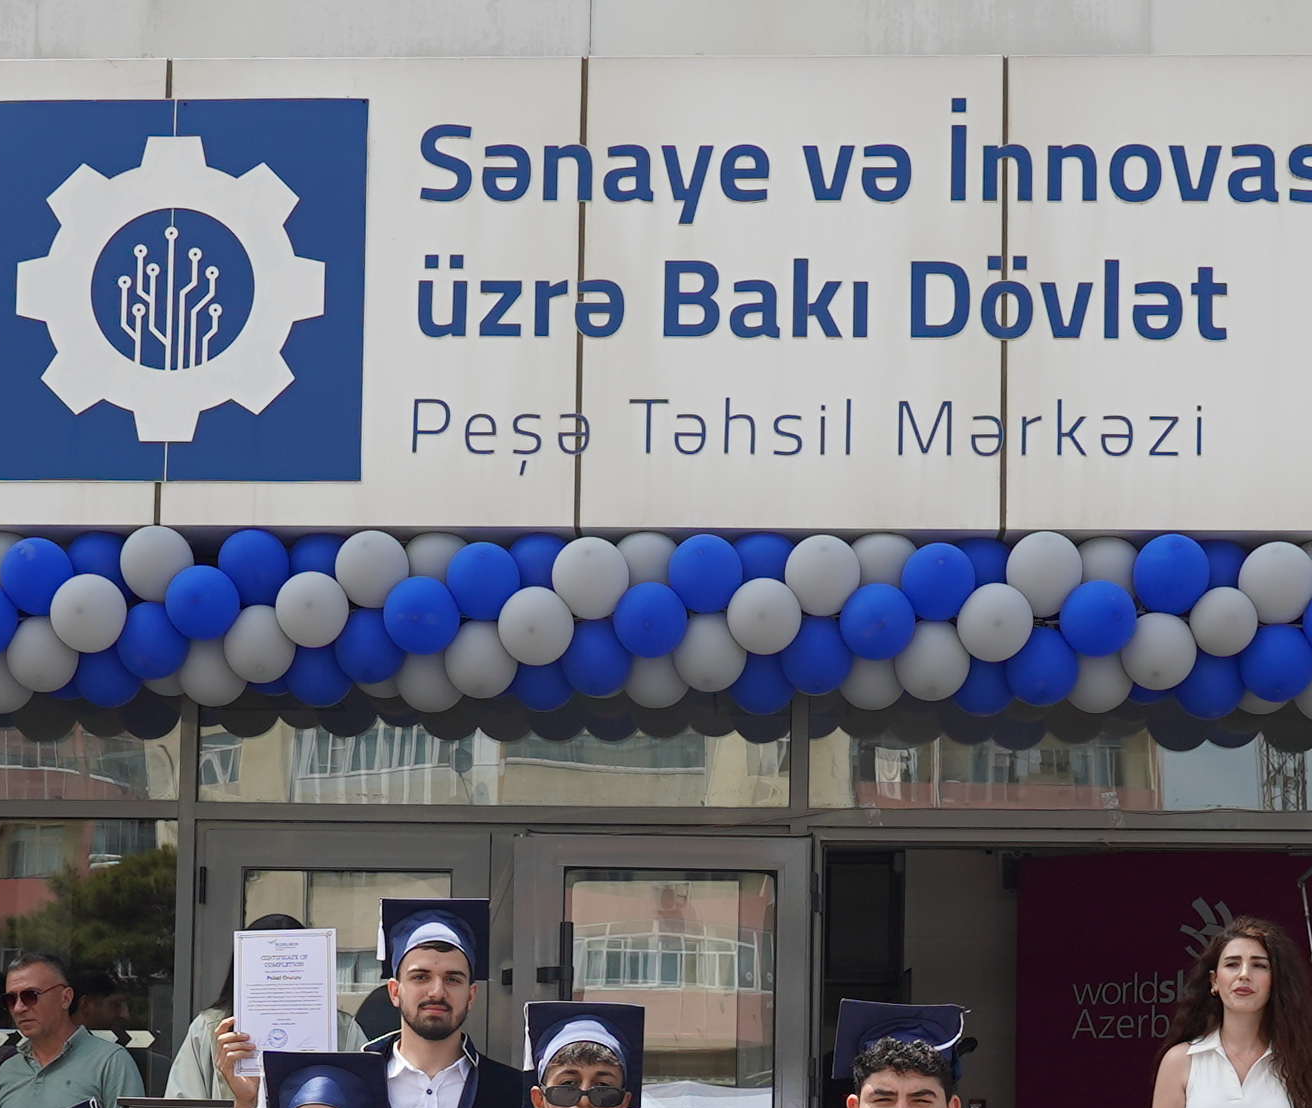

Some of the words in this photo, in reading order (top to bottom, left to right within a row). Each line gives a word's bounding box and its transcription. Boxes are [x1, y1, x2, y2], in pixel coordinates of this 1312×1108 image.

[420, 124, 770, 224] Sənaye
[802, 143, 912, 202] və
[417, 254, 625, 338] üzrə
[663, 258, 869, 339] Bakı
[910, 256, 1227, 341] Dövlət
[410, 398, 591, 475] Peşə
[630, 397, 852, 457] Təhsil
[896, 398, 1206, 458] Mərkəzi
[1071, 1004, 1171, 1040] Azerb
[1072, 969, 1190, 1005] worldsk
